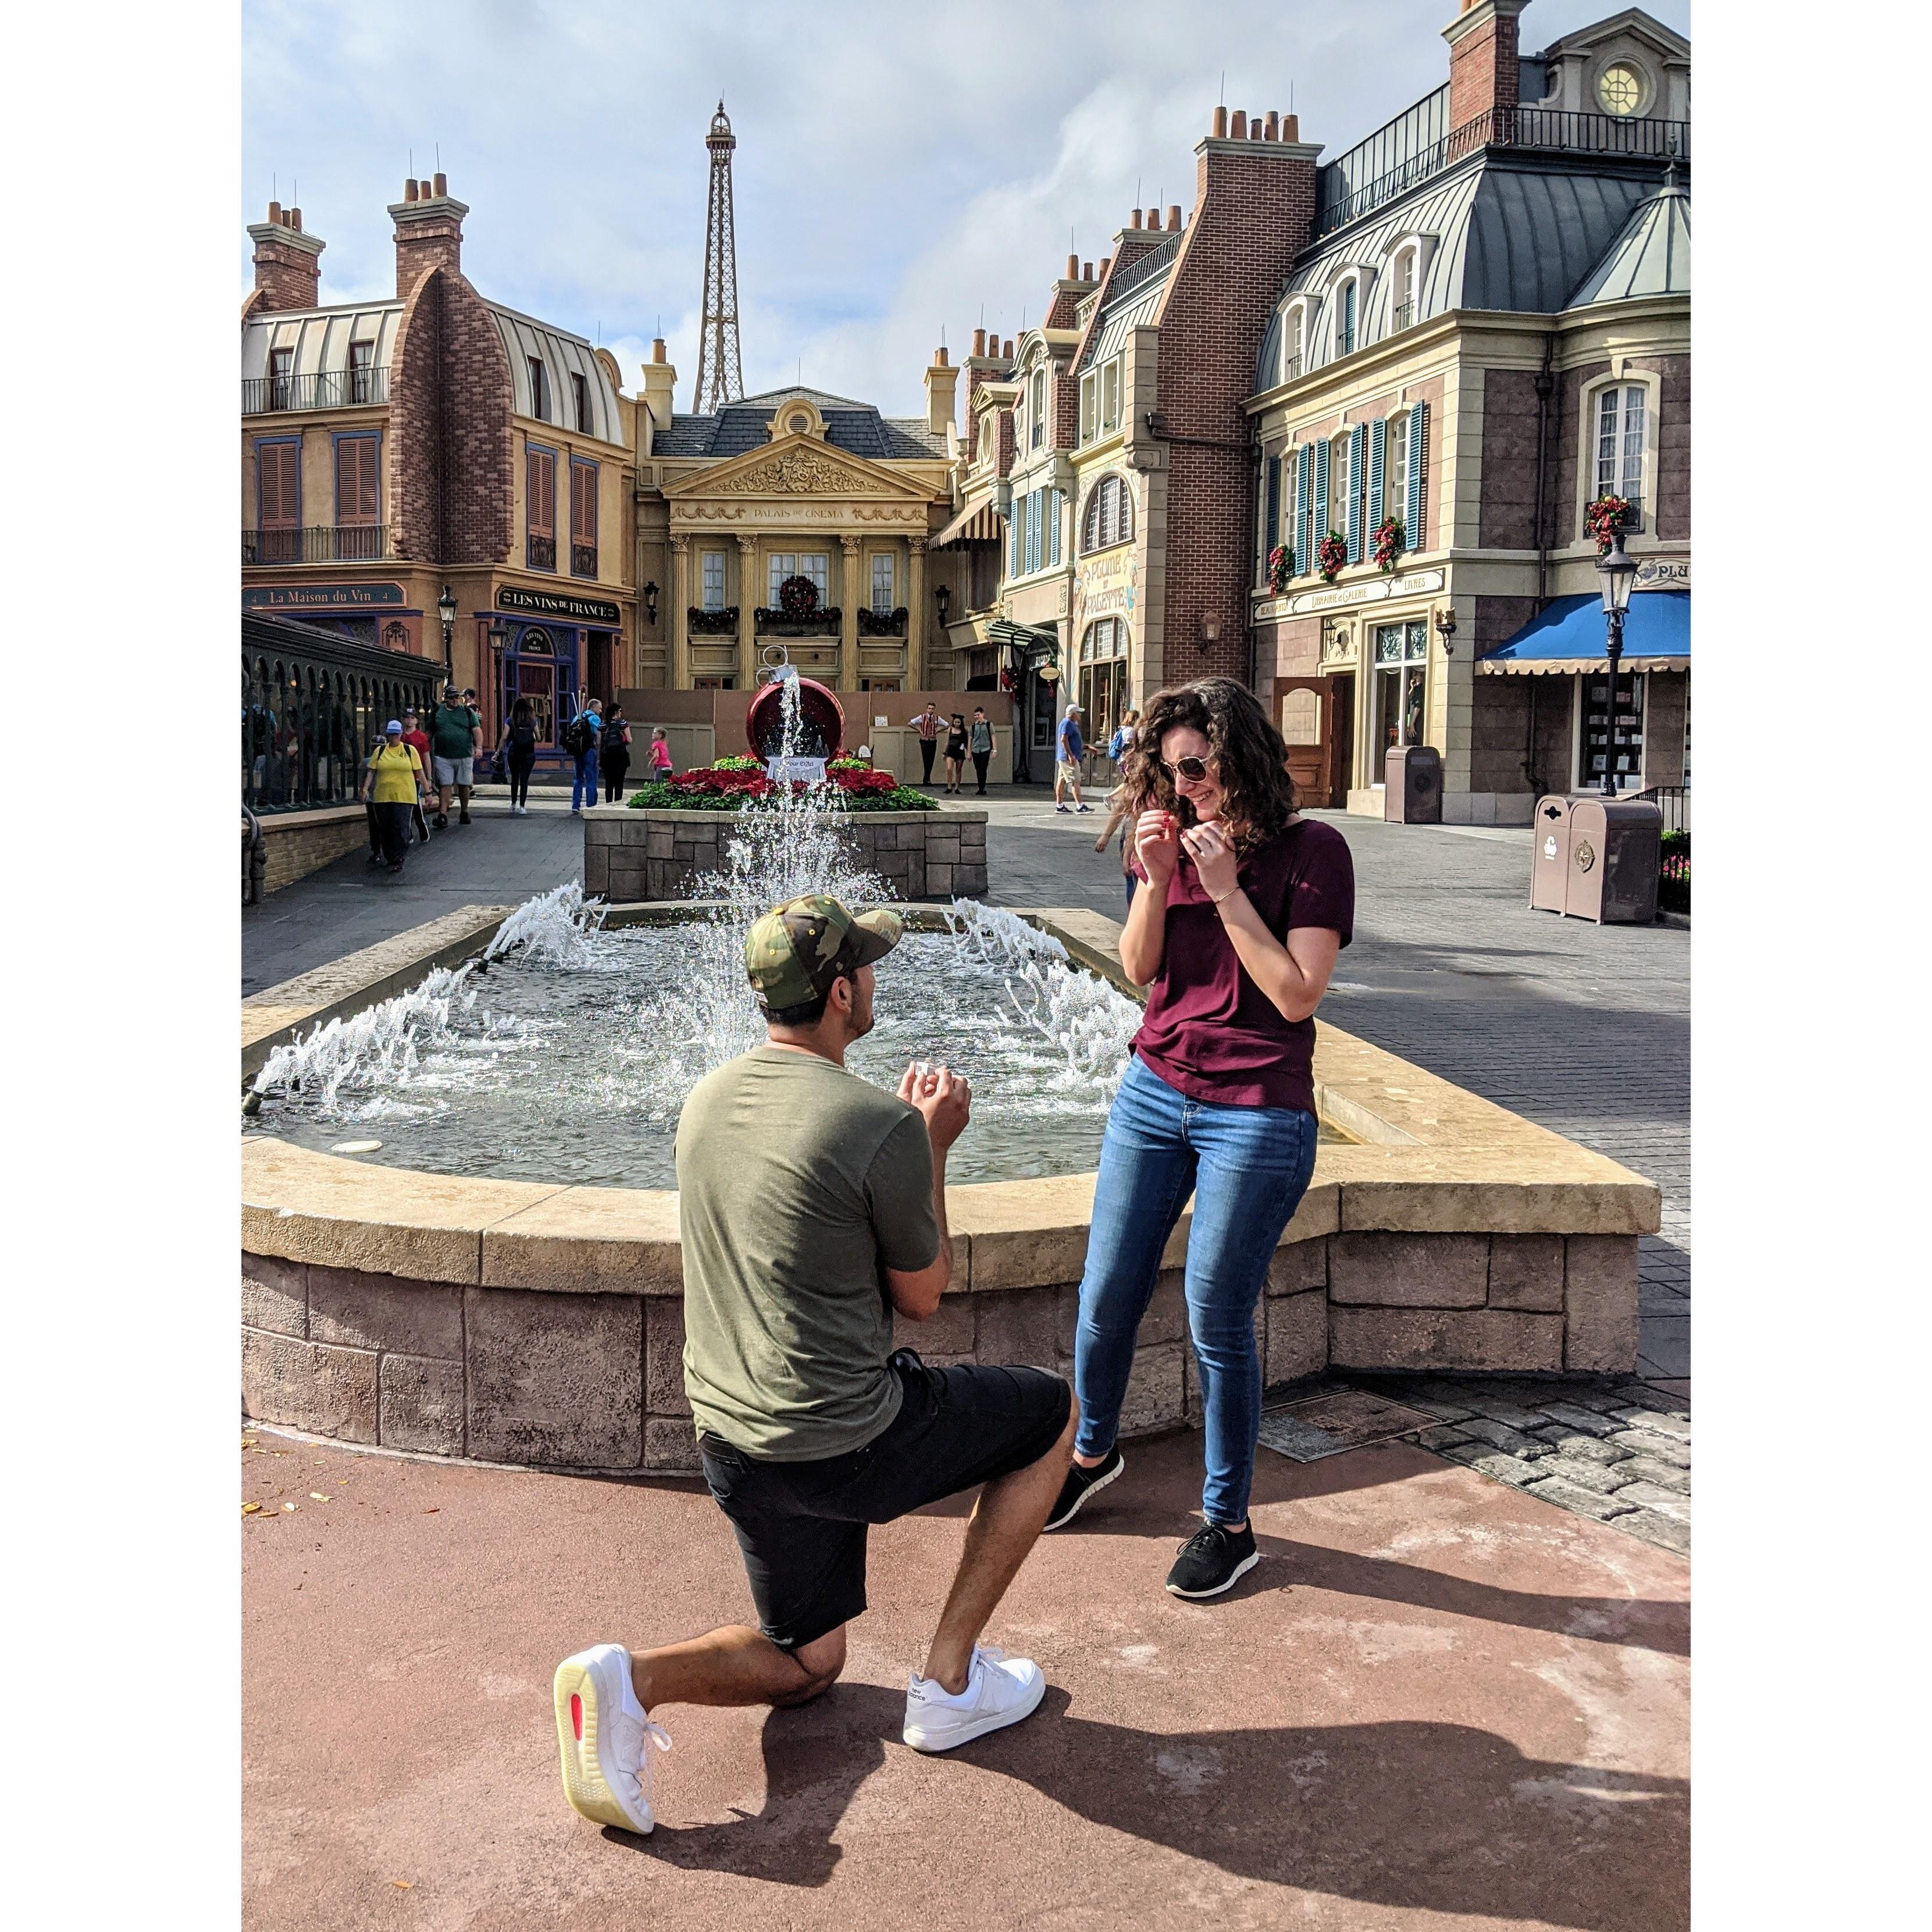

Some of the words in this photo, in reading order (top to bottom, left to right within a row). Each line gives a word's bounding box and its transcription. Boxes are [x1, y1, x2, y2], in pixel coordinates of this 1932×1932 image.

[754, 509, 790, 518] PALAIS
[805, 509, 844, 518] CINEMA
[1658, 565, 1691, 578] PLU
[1405, 578, 1425, 590] LIVRES
[269, 592, 284, 603] La
[288, 591, 329, 603] Maison
[333, 590, 347, 602] du
[351, 589, 372, 601] Vin
[1343, 588, 1367, 603] GALERIE
[513, 593, 533, 607] LES
[534, 596, 558, 610] VINS
[559, 600, 568, 608] DE
[569, 602, 607, 617] FRANCE
